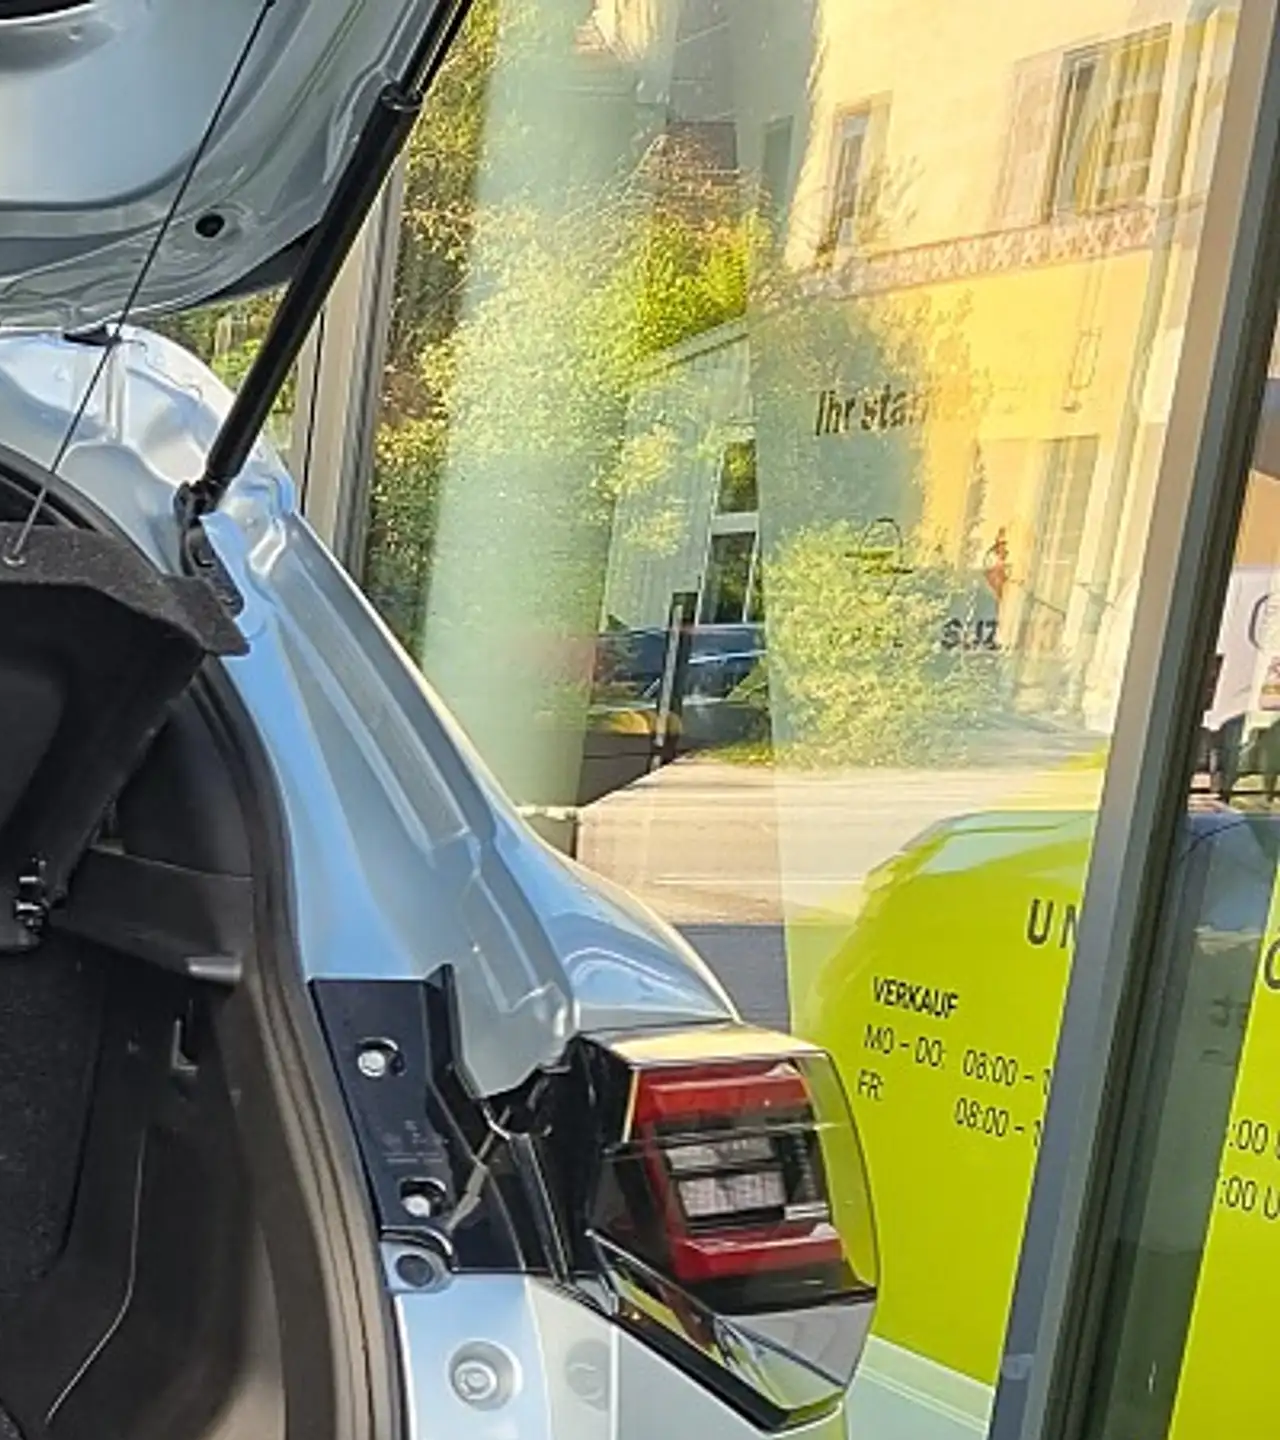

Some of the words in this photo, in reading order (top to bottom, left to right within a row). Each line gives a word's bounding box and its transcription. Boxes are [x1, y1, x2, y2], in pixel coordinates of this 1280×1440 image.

[815, 390, 855, 436] Ihr
[1027, 898, 1078, 948] UN
[873, 976, 958, 1018] VERKAUF
[864, 1023, 894, 1054] MO
[963, 1049, 1017, 1086] 08:00
[857, 1069, 883, 1101] FR:
[955, 1097, 1009, 1136] 08:00
[1228, 1119, 1268, 1154] :00
[1219, 1176, 1257, 1211] :00
